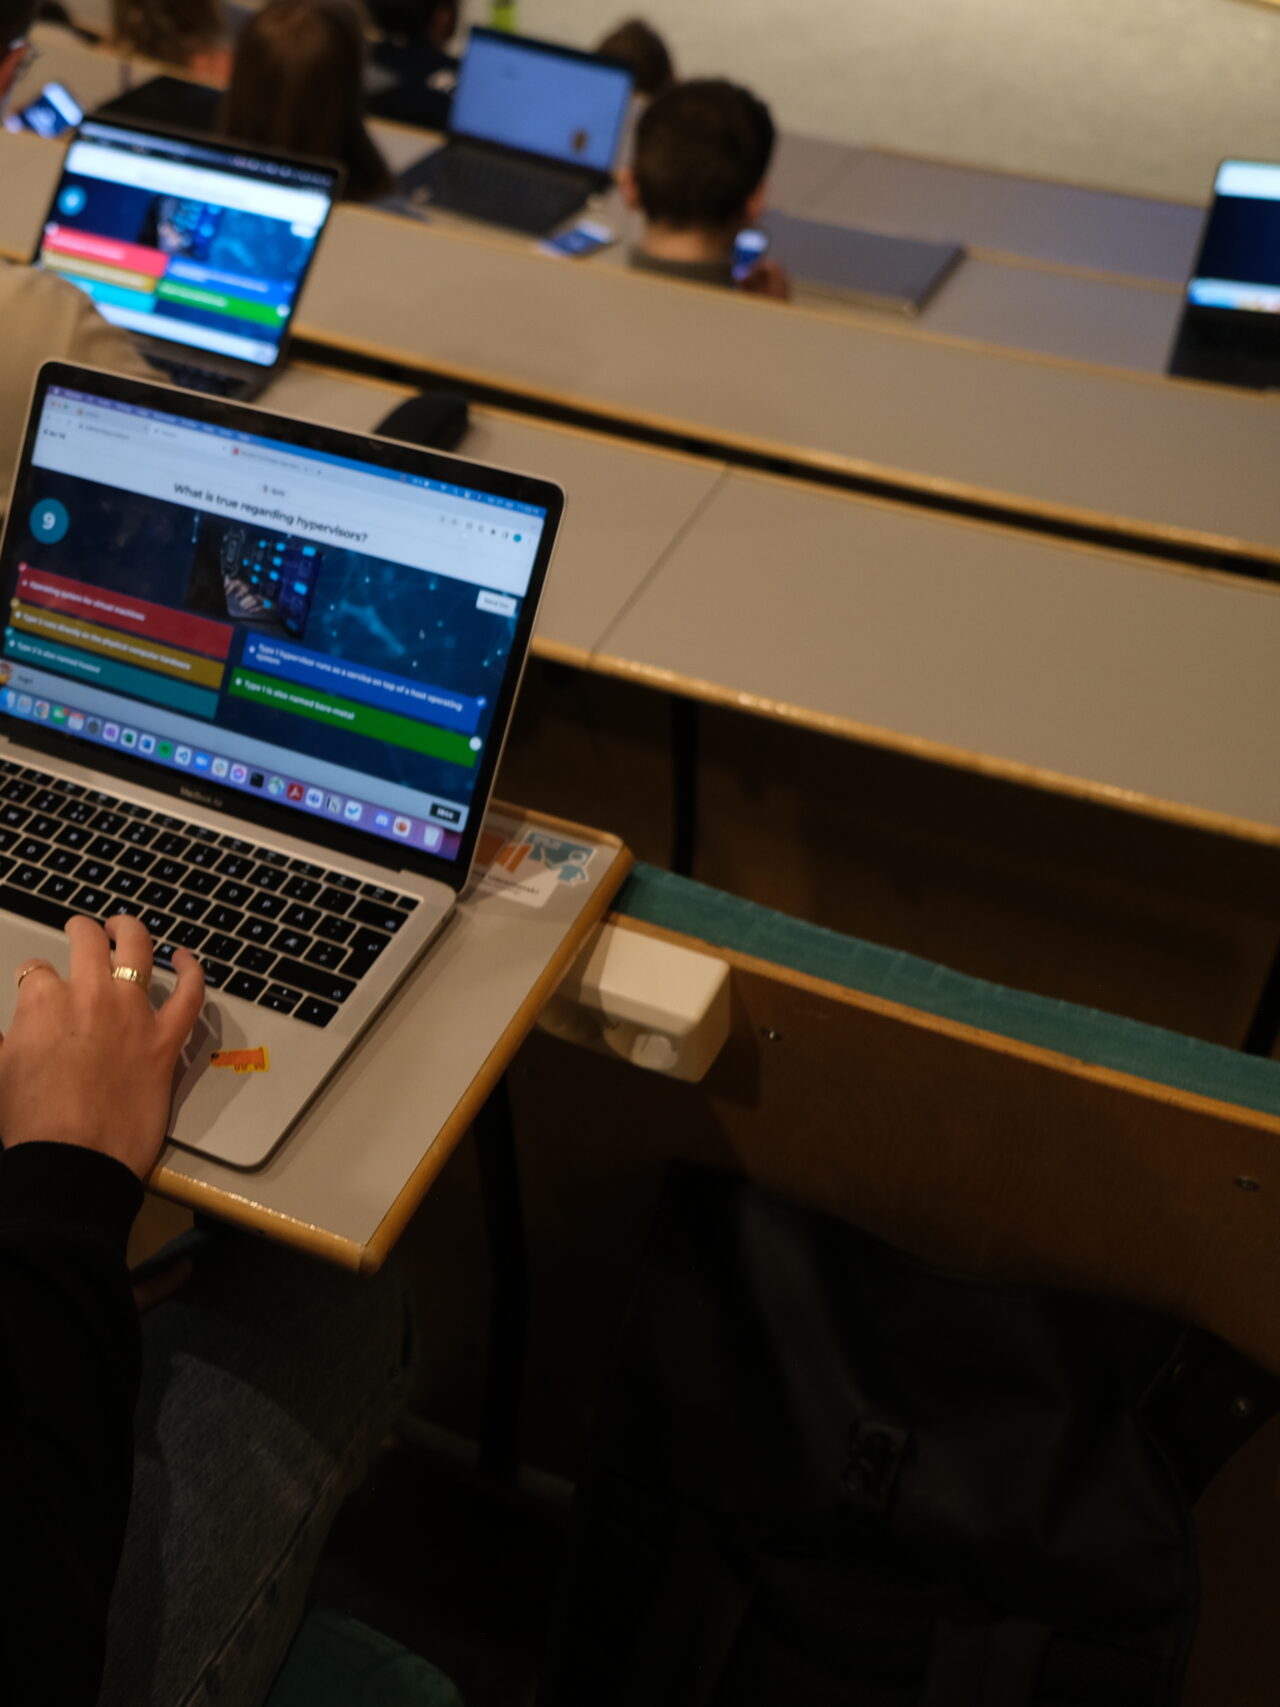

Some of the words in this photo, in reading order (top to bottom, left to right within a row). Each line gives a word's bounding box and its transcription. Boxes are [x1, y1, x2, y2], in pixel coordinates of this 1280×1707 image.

[42, 511, 56, 530] 9
[174, 483, 202, 499] What
[205, 492, 214, 503] is
[216, 494, 239, 509] true
[240, 502, 294, 526] regarding
[296, 515, 368, 542] hypervisors?
[114, 604, 145, 622] machines
[17, 641, 31, 654] Type
[23, 612, 37, 625] Type
[57, 622, 80, 640] directly
[90, 632, 101, 643] the
[102, 636, 128, 652] physical
[128, 643, 159, 661] computer
[159, 652, 191, 671] hardware
[258, 643, 274, 656] Type
[315, 659, 330, 671] runs
[346, 668, 371, 684] service
[372, 676, 382, 686] on
[382, 678, 395, 692] top
[396, 682, 405, 693] of
[410, 687, 426, 700] host
[427, 693, 463, 712] operating
[244, 679, 260, 693] Type
[273, 685, 288, 699] also
[288, 691, 314, 707] named
[314, 697, 355, 720] bare-metal
